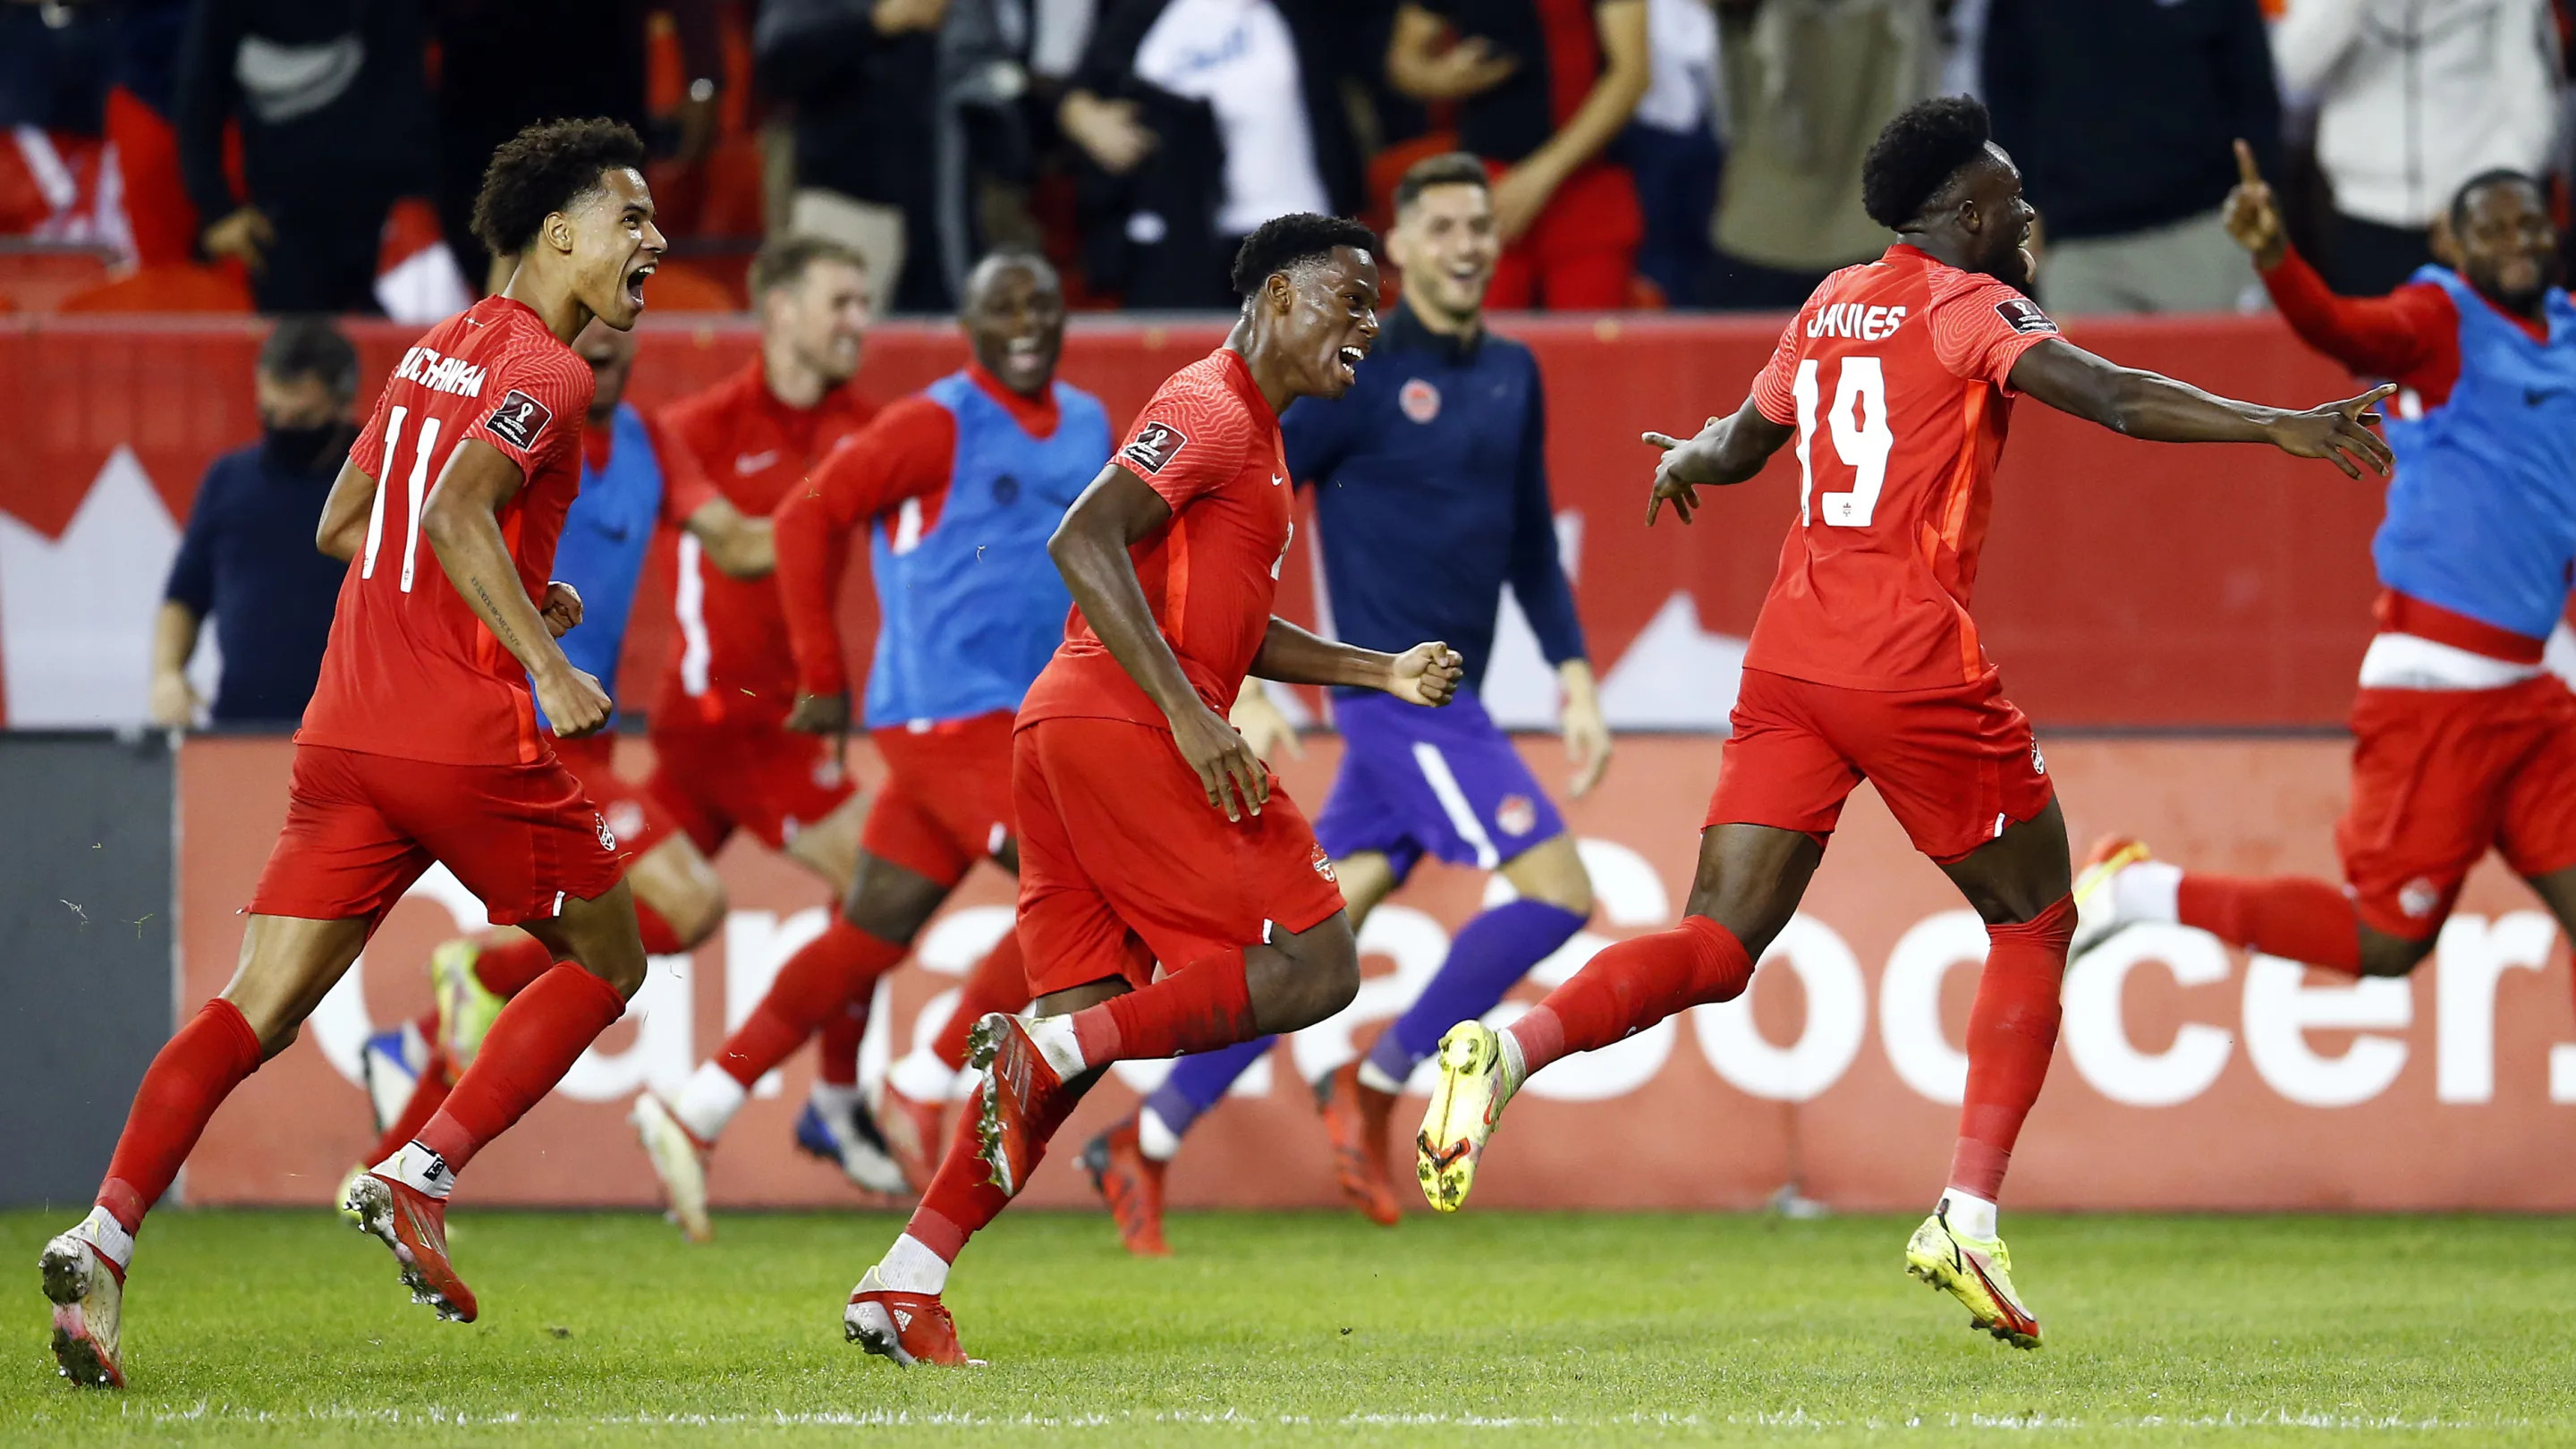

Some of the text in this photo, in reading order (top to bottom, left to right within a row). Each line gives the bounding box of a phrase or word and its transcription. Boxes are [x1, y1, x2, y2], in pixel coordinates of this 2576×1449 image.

[361, 405, 441, 593] 11
[496, 421, 522, 445] Qualifiers
[1792, 356, 1895, 528] 19
